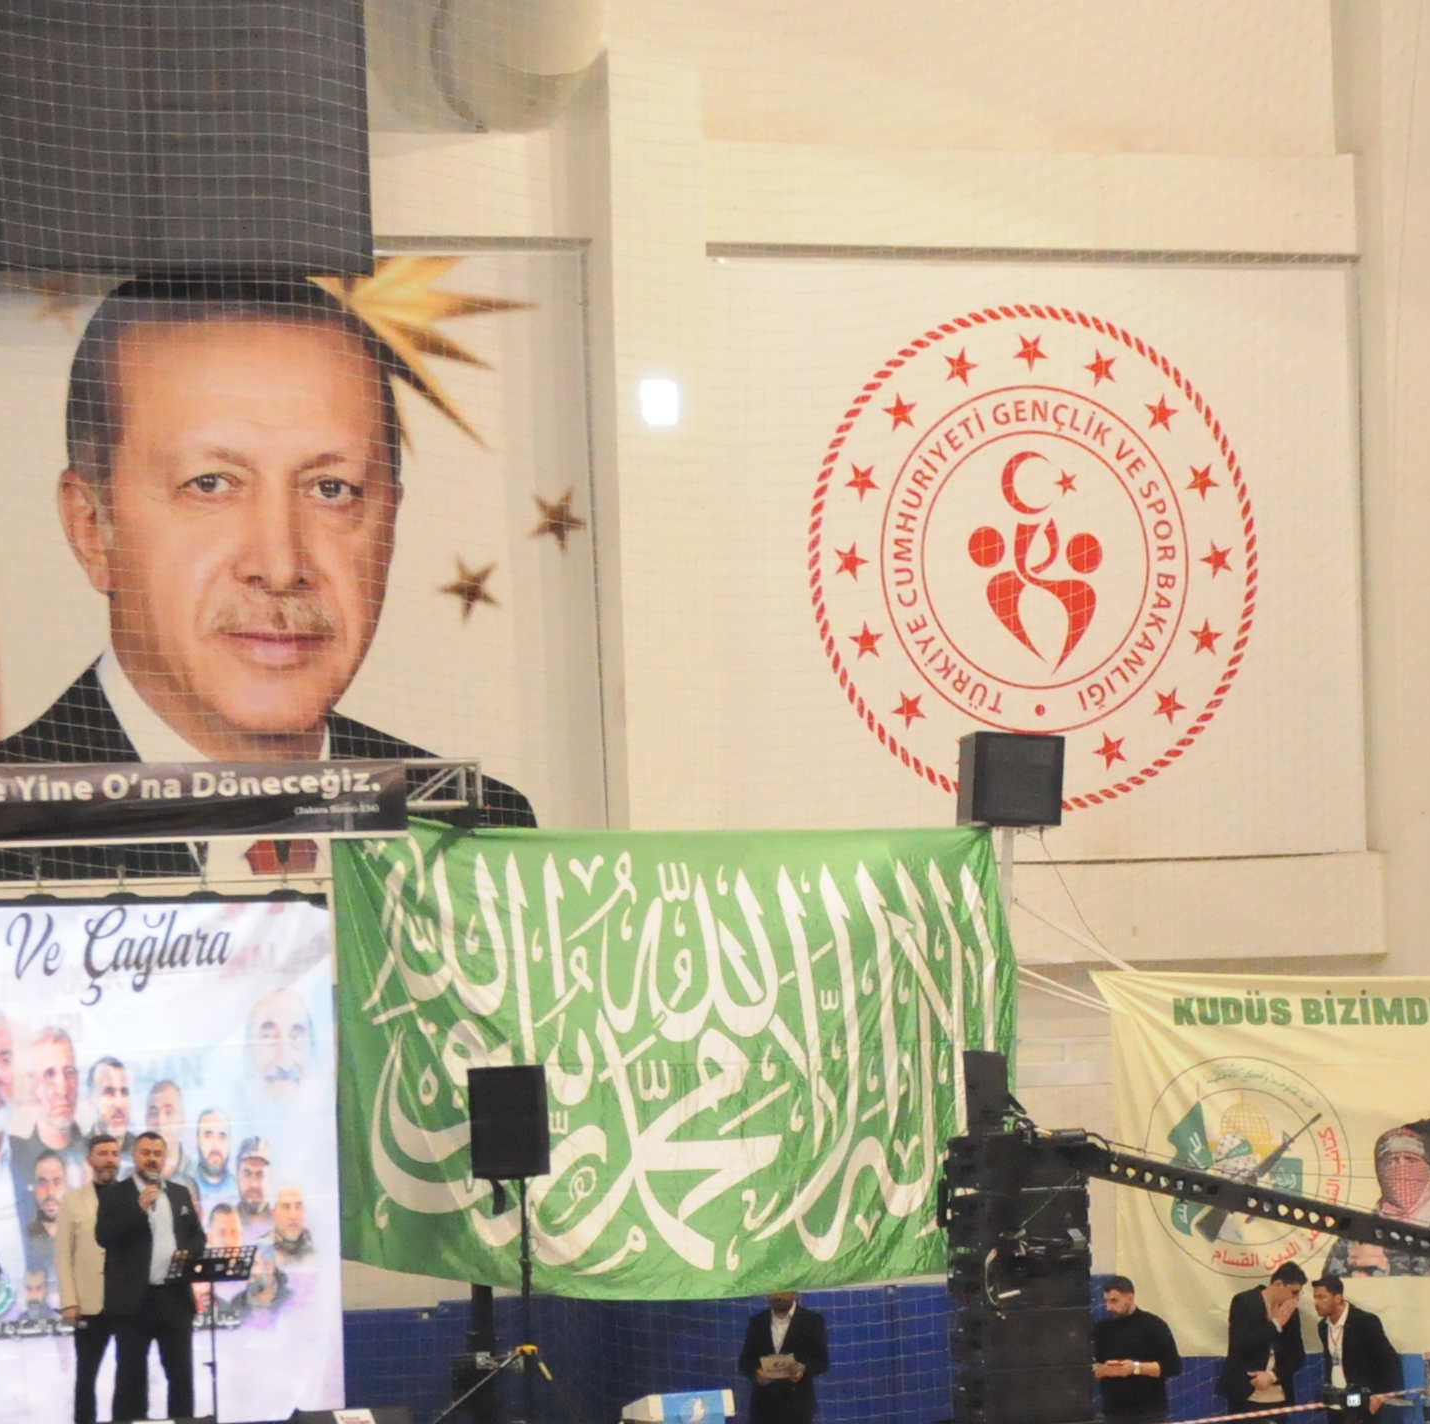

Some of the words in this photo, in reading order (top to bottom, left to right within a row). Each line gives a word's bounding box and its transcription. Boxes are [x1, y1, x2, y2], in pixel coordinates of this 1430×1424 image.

[991, 398, 1112, 448] GENÇLİK
[1117, 438, 1145, 478] VE
[893, 404, 986, 609] CUMHURİYETİ
[1138, 479, 1176, 563] SPOR
[906, 613, 1003, 715] TÜRKİYE
[1076, 573, 1177, 712] BAKANLIĞI
[16, 774, 94, 801] Yine
[192, 769, 382, 800] Döneceğiz.
[5, 912, 61, 981] Ve
[79, 906, 232, 1006] Çağlara
[1172, 989, 1293, 1026] KUDÜS
[1211, 1249, 1260, 1268] القسام
